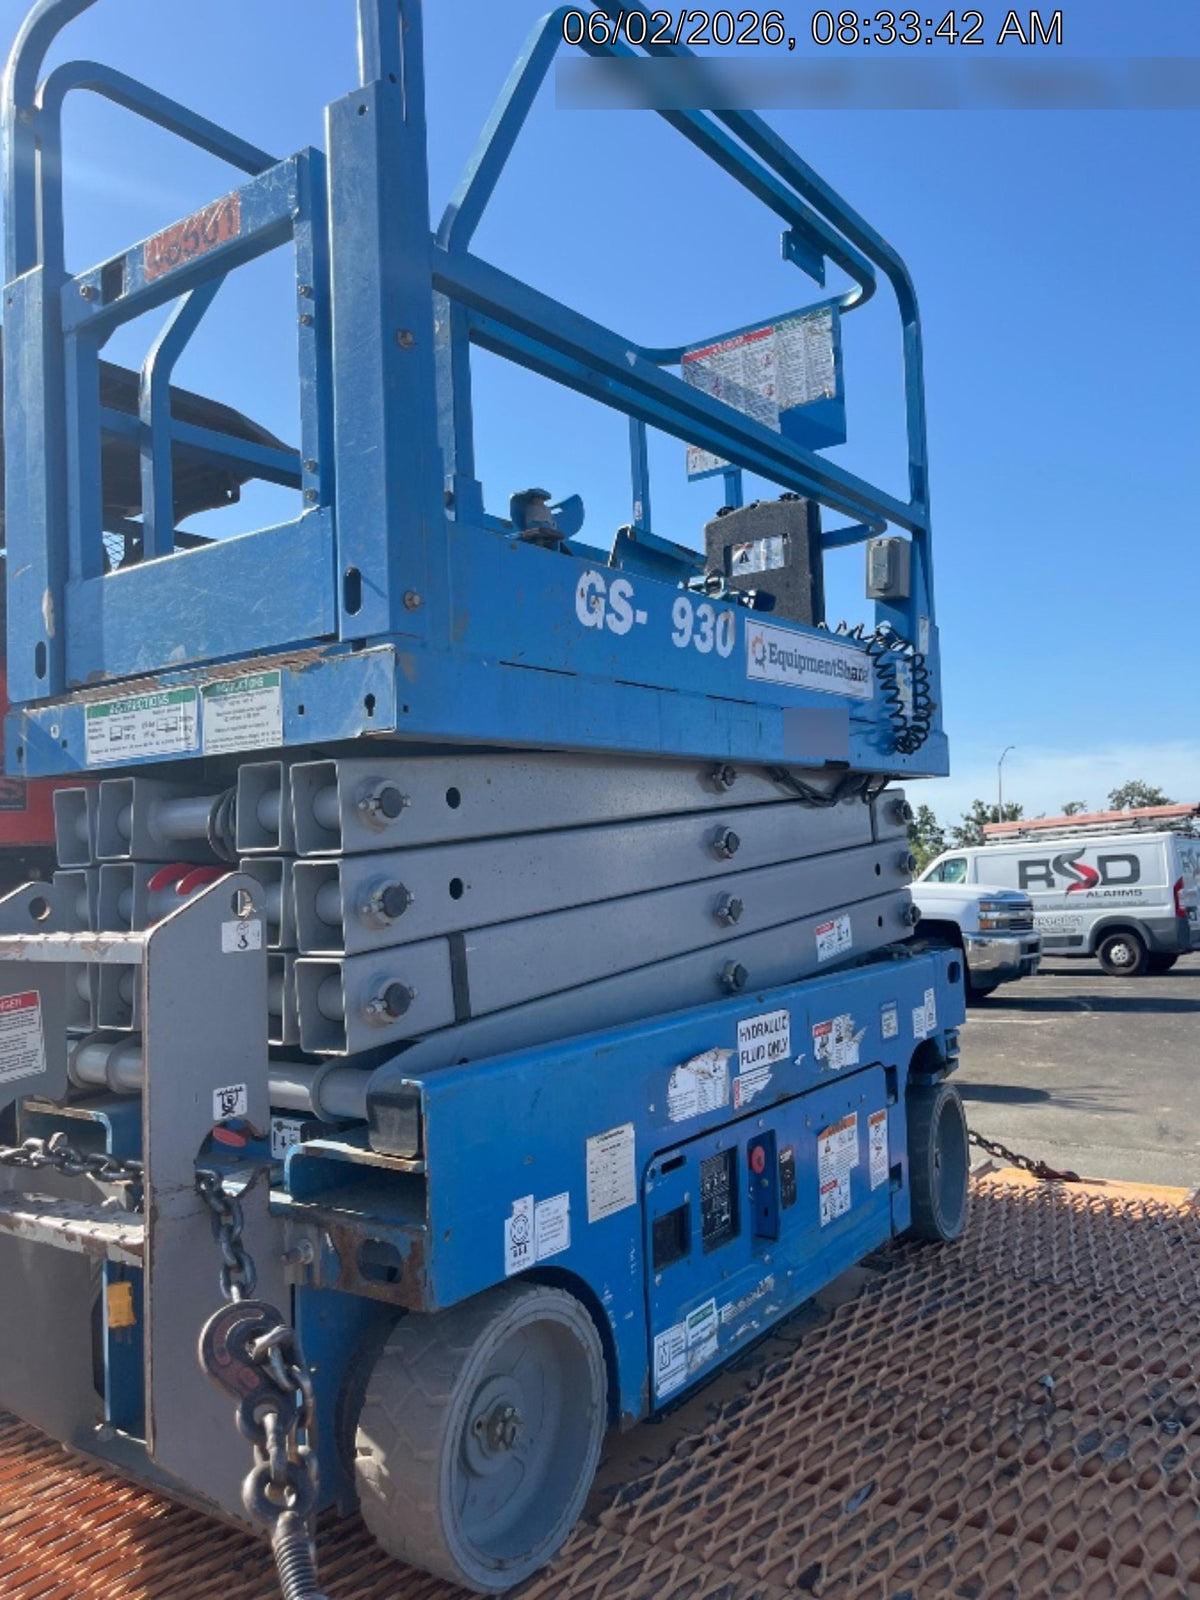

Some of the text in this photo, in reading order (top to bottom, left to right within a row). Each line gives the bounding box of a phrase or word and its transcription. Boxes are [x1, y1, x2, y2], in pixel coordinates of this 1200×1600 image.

[575, 570, 735, 658] GS- 930
[768, 641, 869, 683] EquipmentShare
[1018, 846, 1141, 898] RSD
[739, 1014, 787, 1042] HYDRAULIC
[741, 1036, 788, 1066] FLUID ONLY
